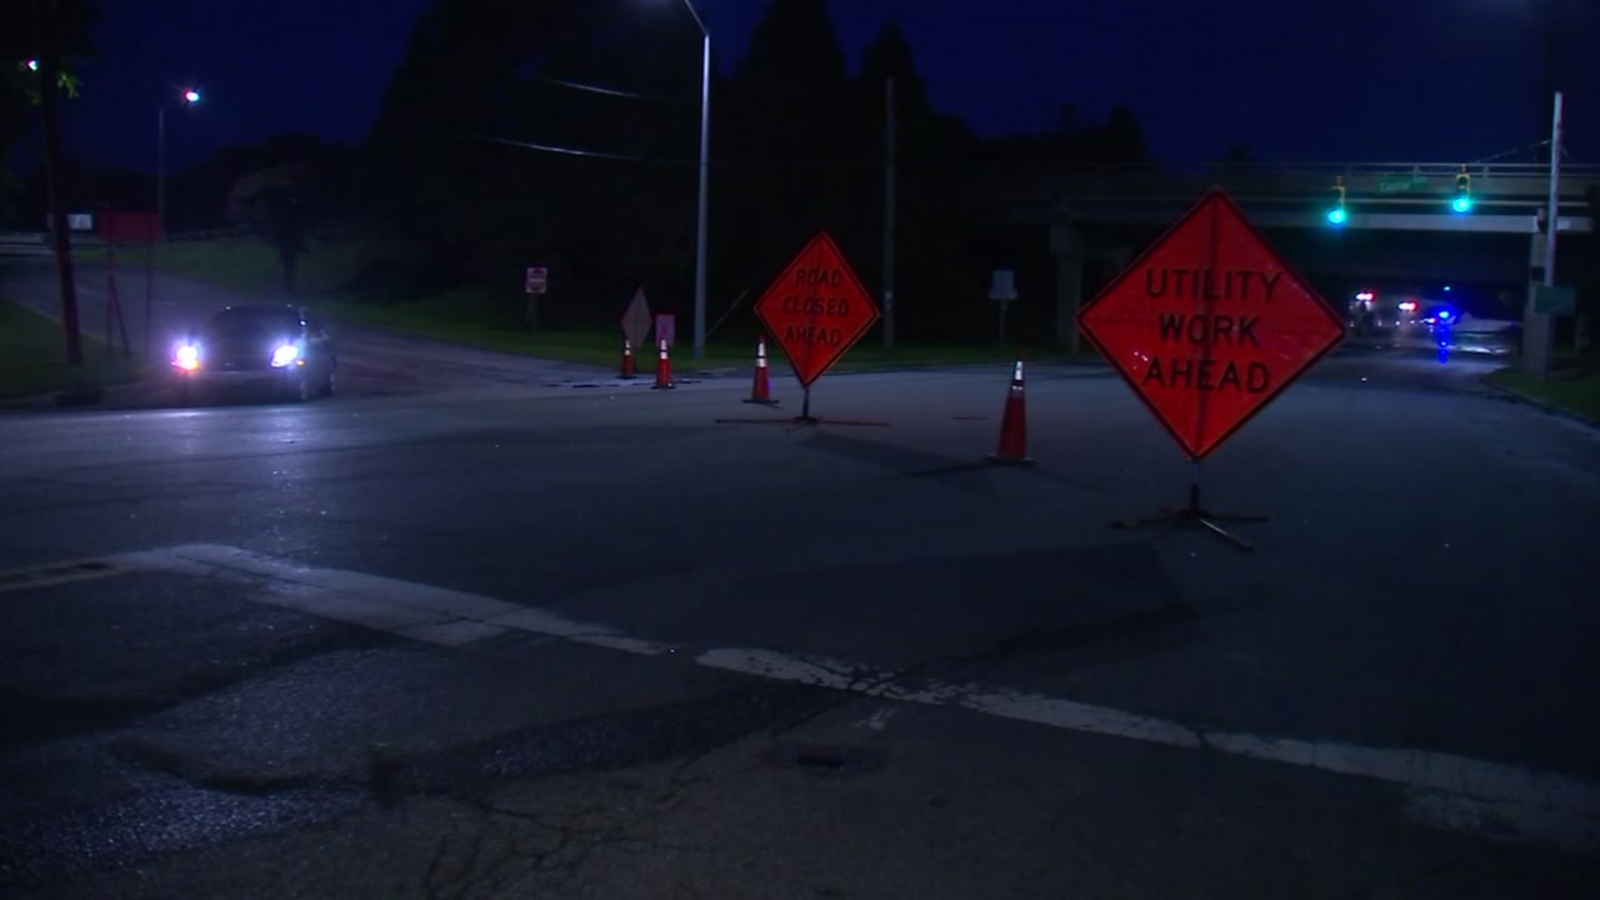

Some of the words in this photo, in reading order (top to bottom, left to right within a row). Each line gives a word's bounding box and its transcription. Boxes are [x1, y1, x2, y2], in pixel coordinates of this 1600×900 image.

[796, 269, 841, 287] ROAD
[1146, 269, 1284, 302] UTILITY
[783, 297, 848, 317] CLOSED
[785, 326, 842, 346] AHEAD
[1160, 313, 1260, 347] WORK
[1141, 358, 1270, 394] AHEAD
